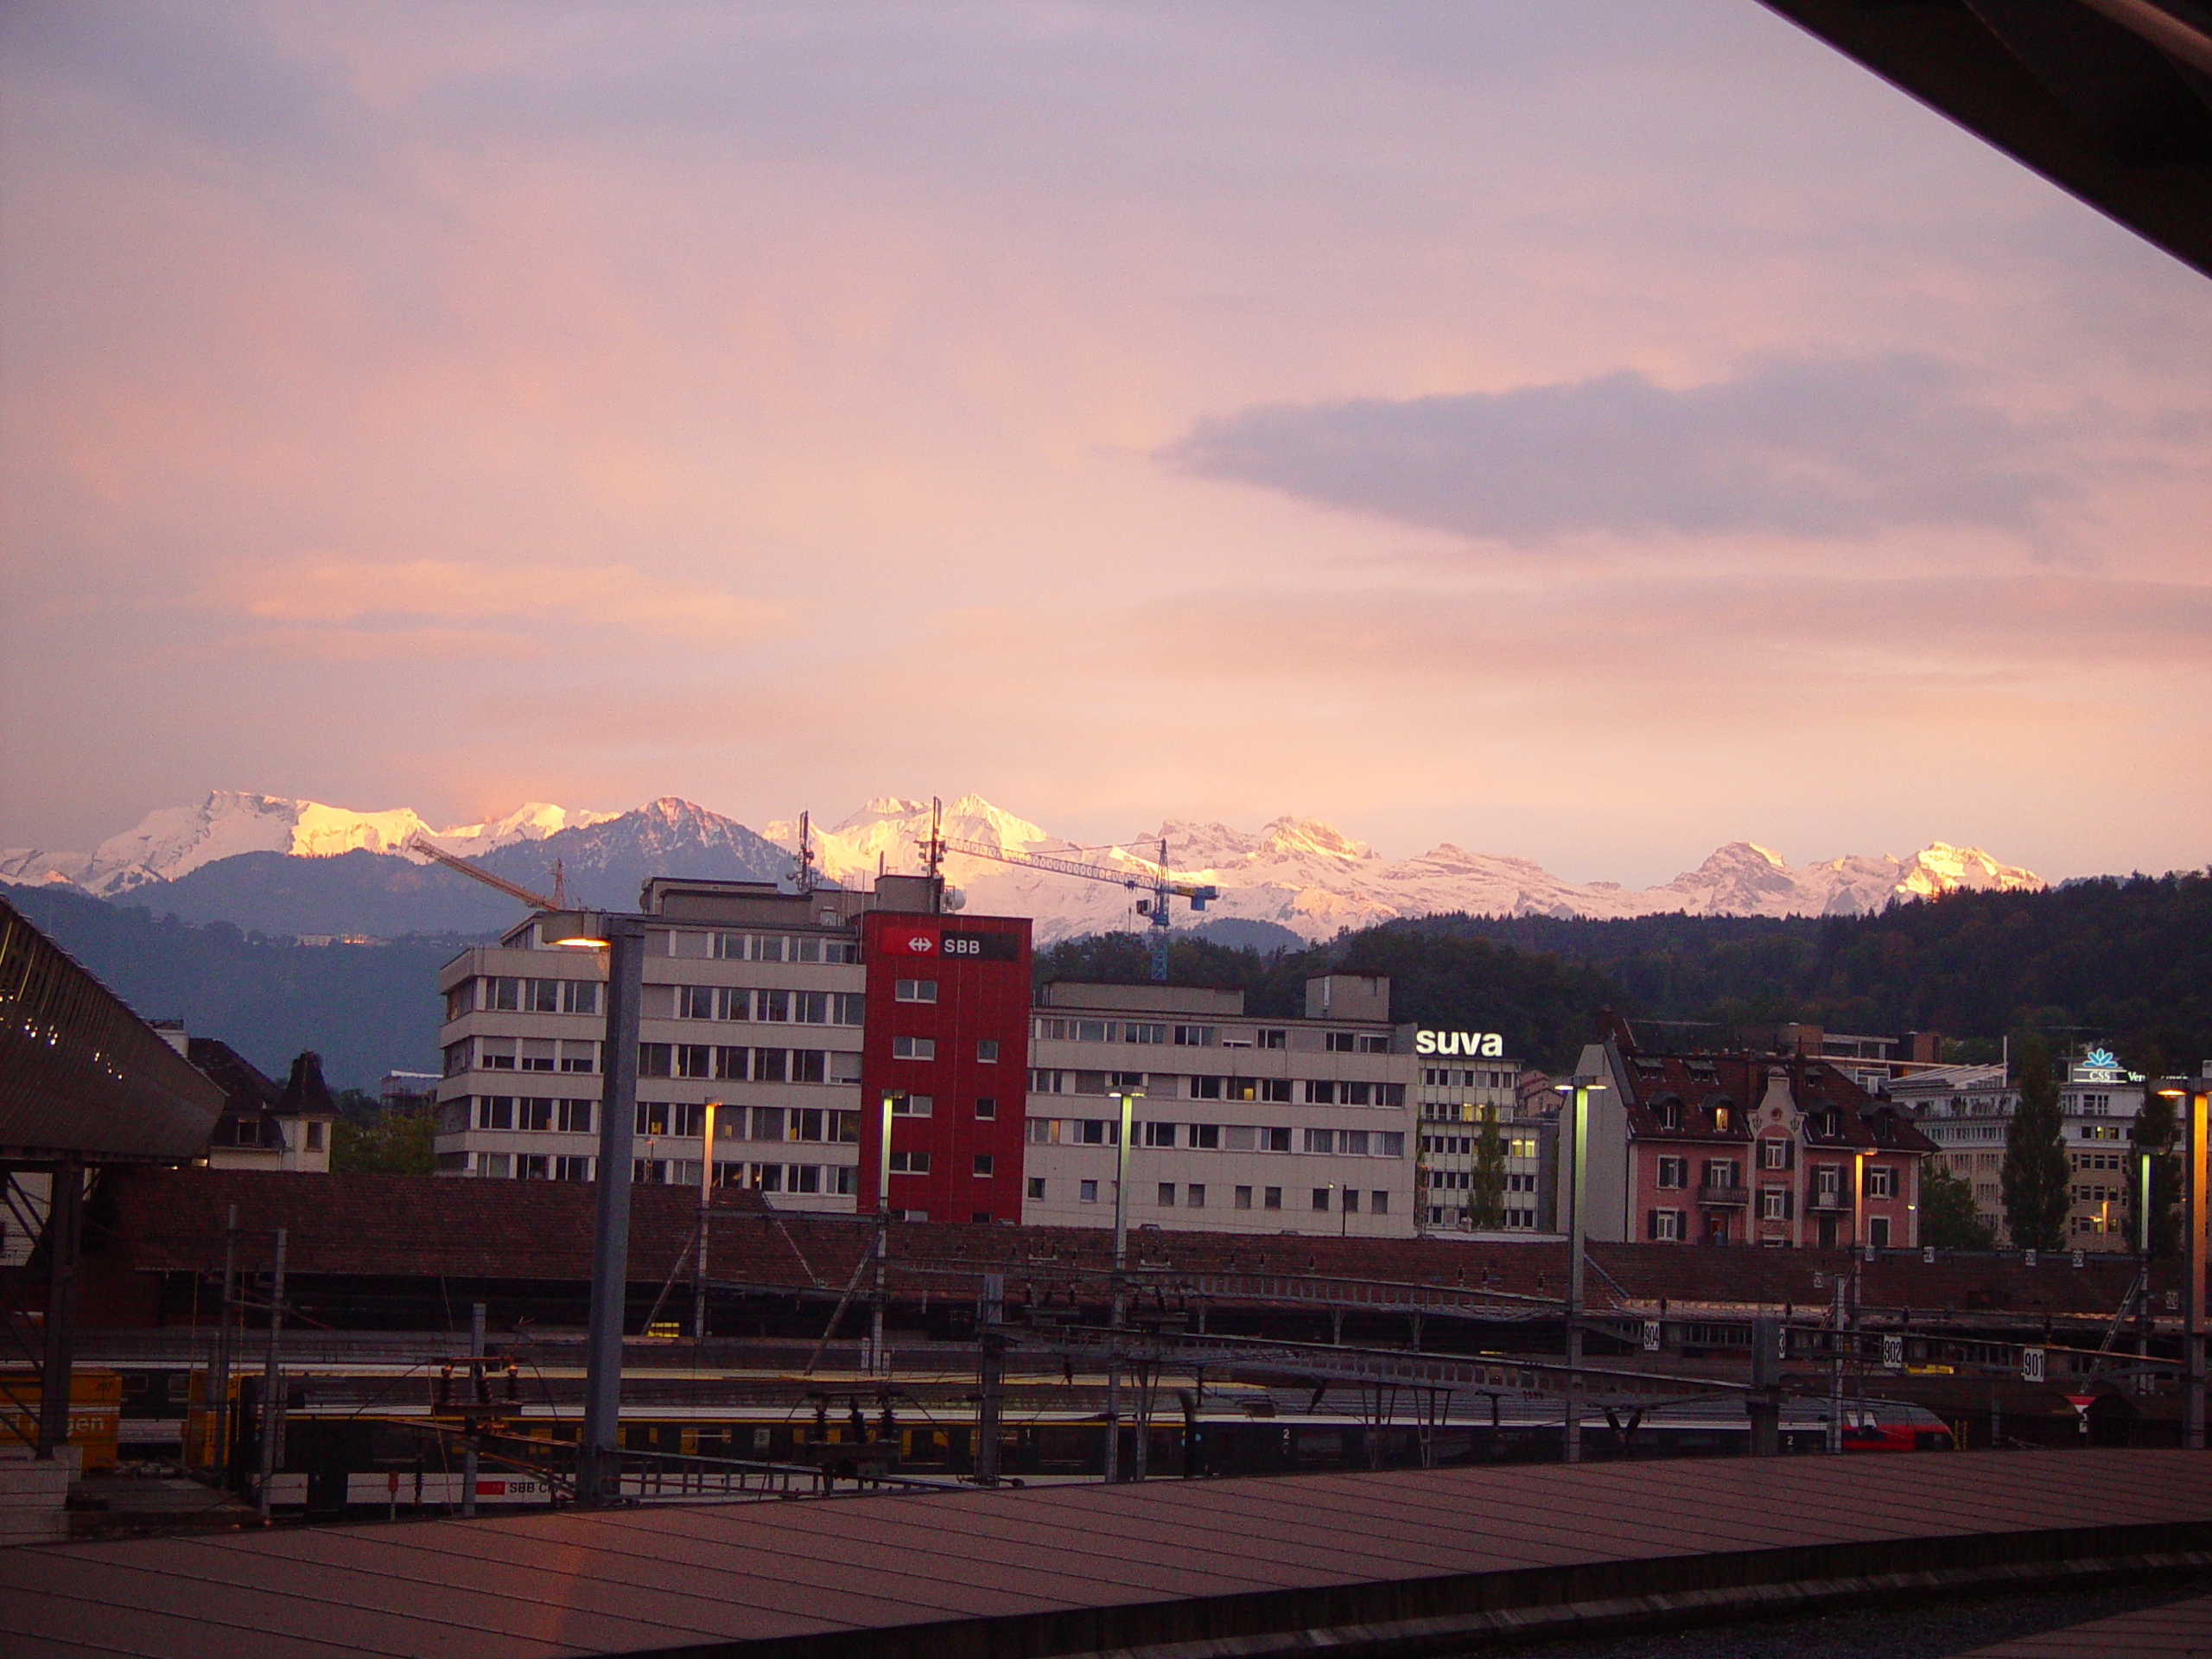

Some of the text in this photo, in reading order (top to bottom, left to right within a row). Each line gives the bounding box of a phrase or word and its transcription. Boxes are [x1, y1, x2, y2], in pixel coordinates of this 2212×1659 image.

[944, 938, 980, 955] SBB
[1415, 1029, 1503, 1058] suva
[2089, 1071, 2110, 1081] CSS
[1644, 1325, 1658, 1346] 904
[1885, 1341, 1900, 1363] 902
[2024, 1352, 2043, 1376] 901
[1282, 1428, 1290, 1440] 2
[1787, 1435, 1794, 1446] 2
[510, 1482, 535, 1493] SBB
